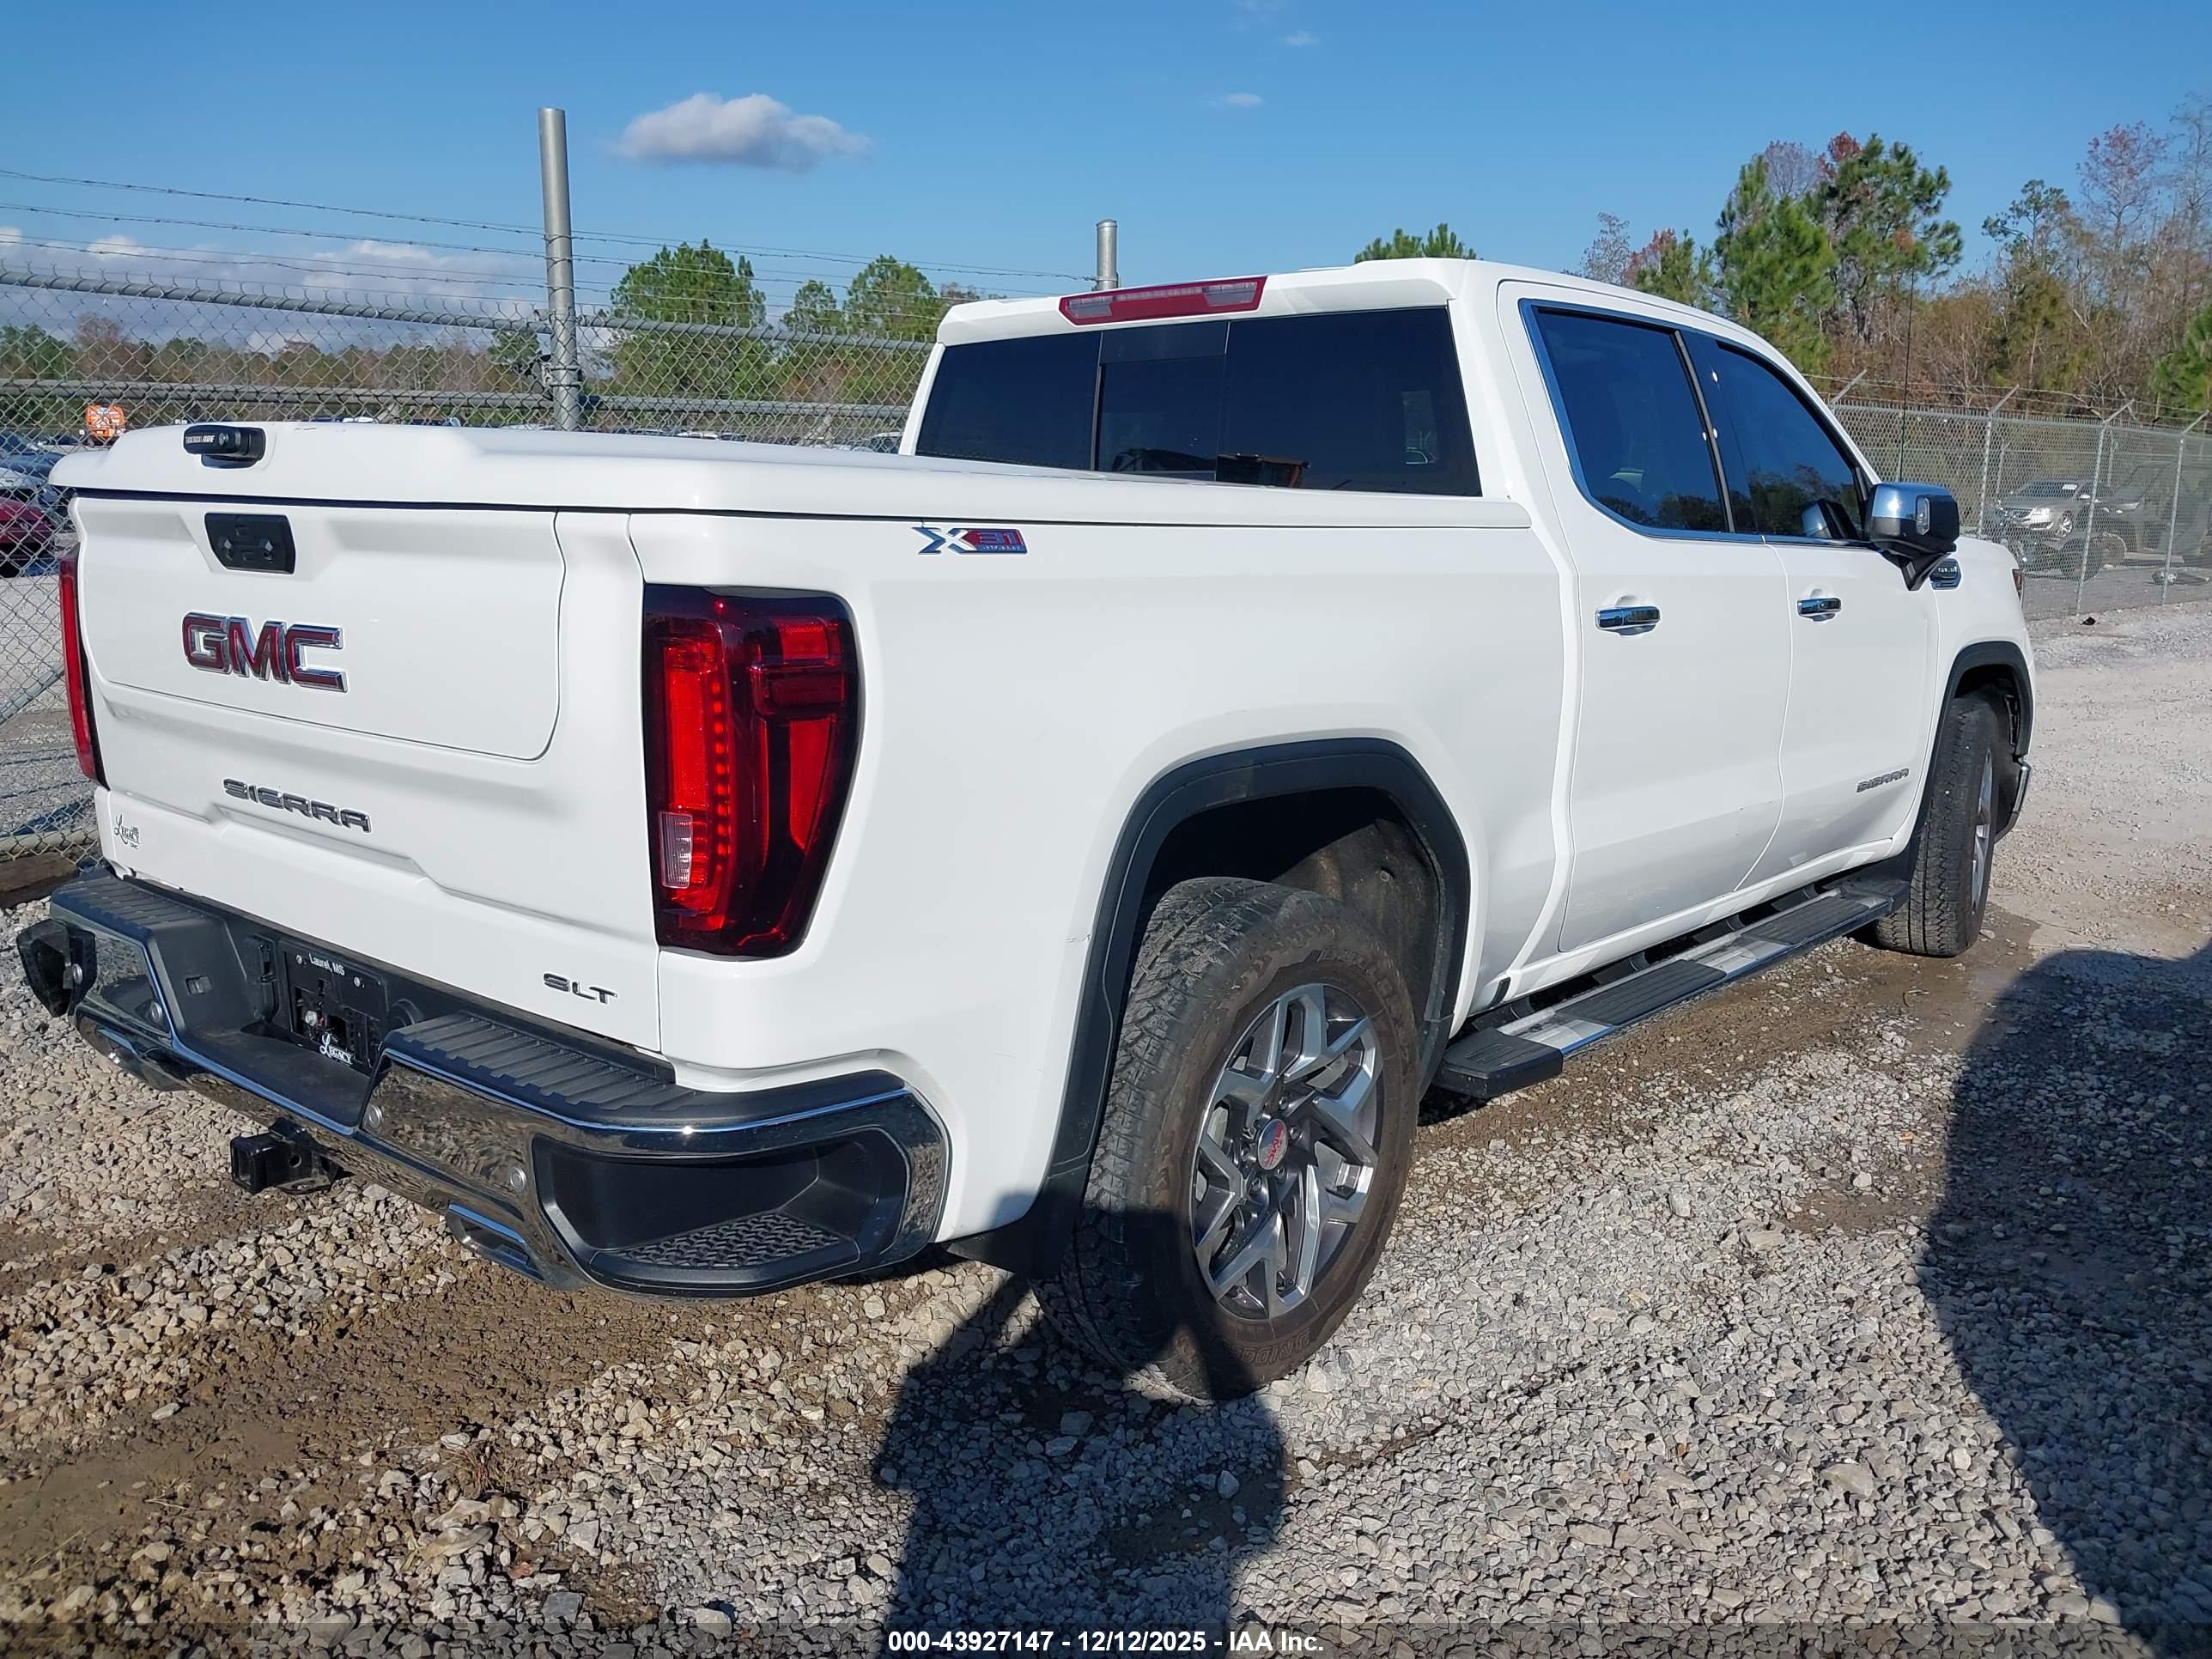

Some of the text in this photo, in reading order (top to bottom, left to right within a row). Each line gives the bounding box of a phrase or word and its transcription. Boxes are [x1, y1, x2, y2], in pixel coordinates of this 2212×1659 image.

[182, 611, 348, 693] GMC
[1856, 768, 1909, 793] SIERRA
[222, 777, 372, 833] SIERRA
[331, 962, 345, 976] MS
[543, 972, 618, 1005] SLT
